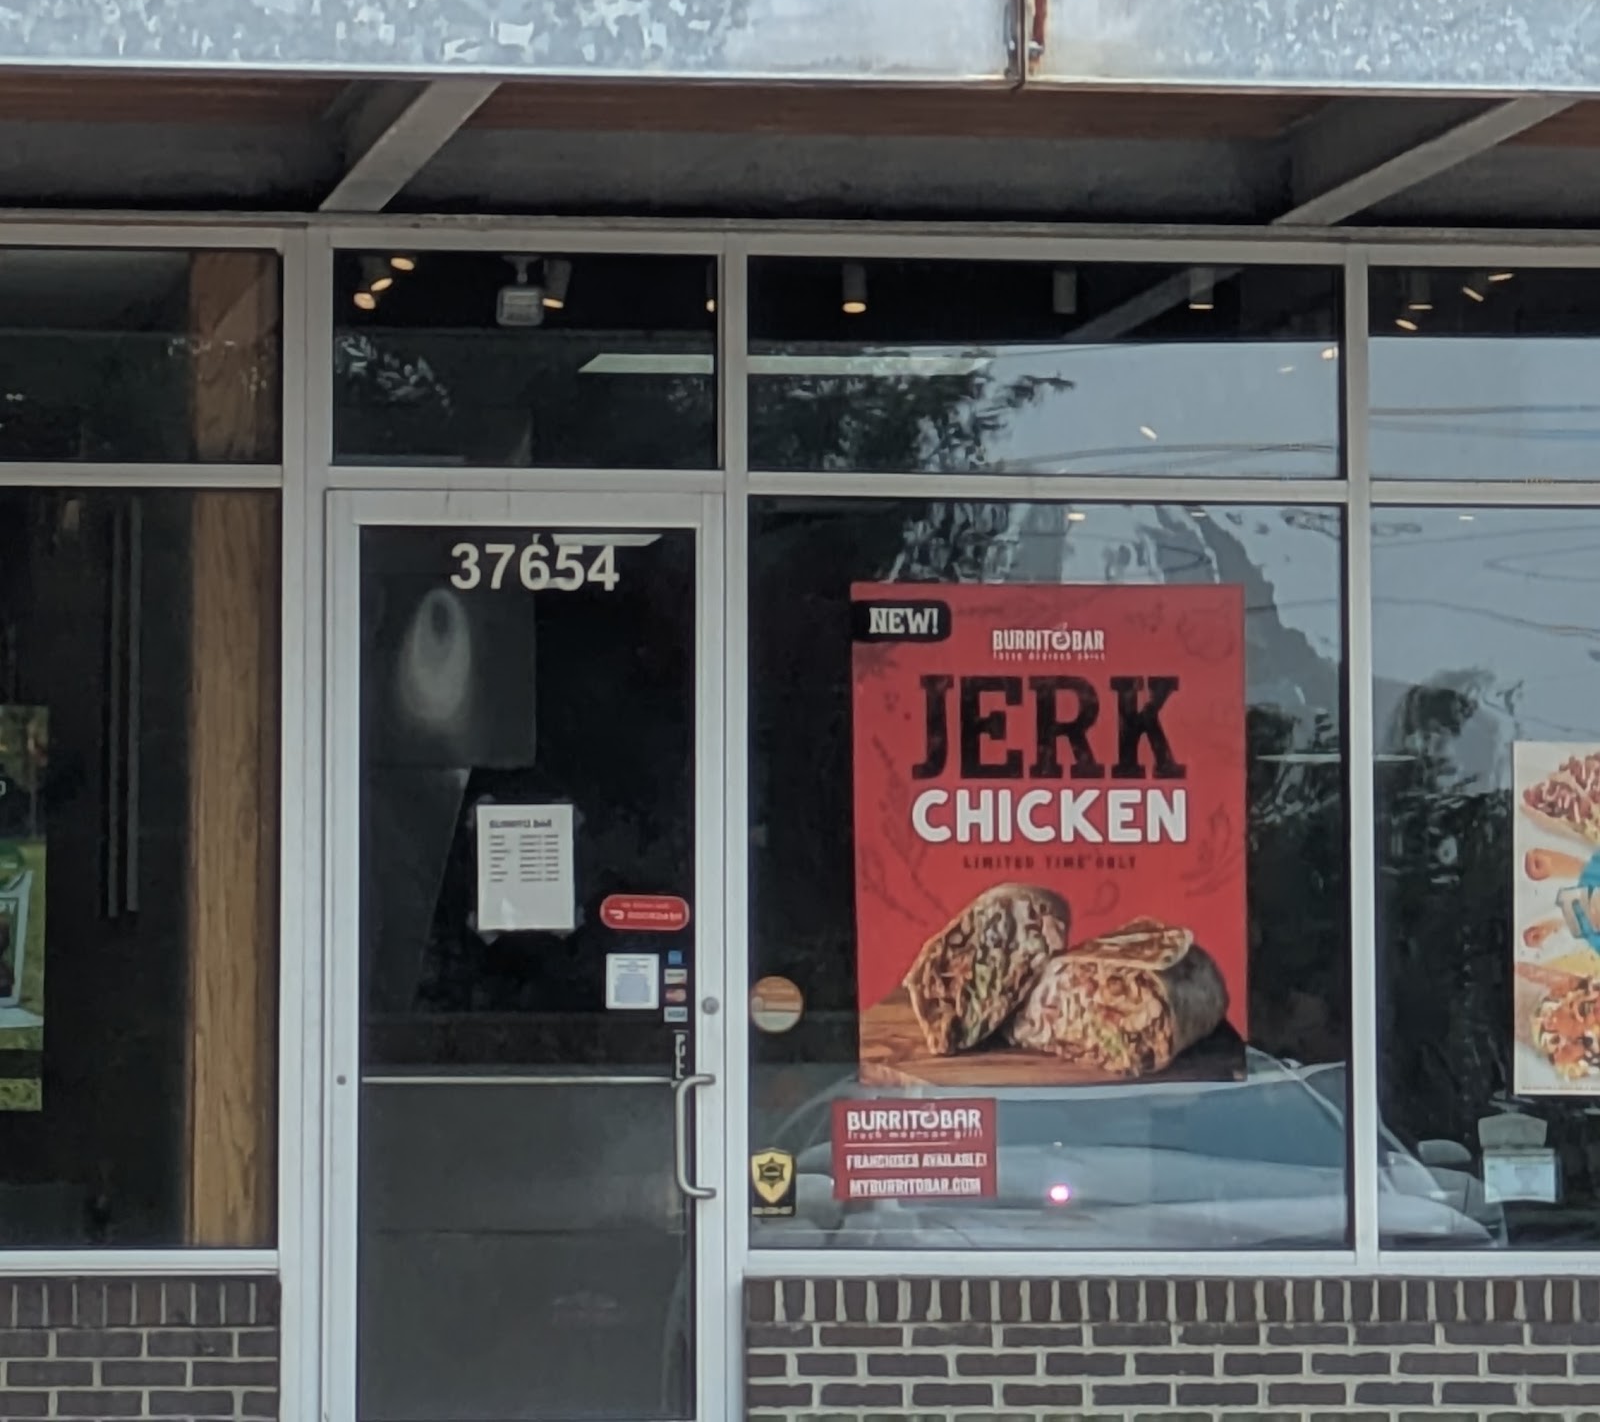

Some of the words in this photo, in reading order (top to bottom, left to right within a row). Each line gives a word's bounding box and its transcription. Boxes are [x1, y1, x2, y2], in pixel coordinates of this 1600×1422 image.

[450, 541, 620, 591] 37654
[868, 606, 939, 635] NEW!
[911, 674, 1187, 779] JERK
[911, 788, 1188, 843] CHICKEN
[963, 856, 1034, 869] LIMITED
[1046, 856, 1085, 869] TIME
[1096, 856, 1136, 869] ONLY
[849, 1178, 982, 1197] MYBURRITOBAR.COM
